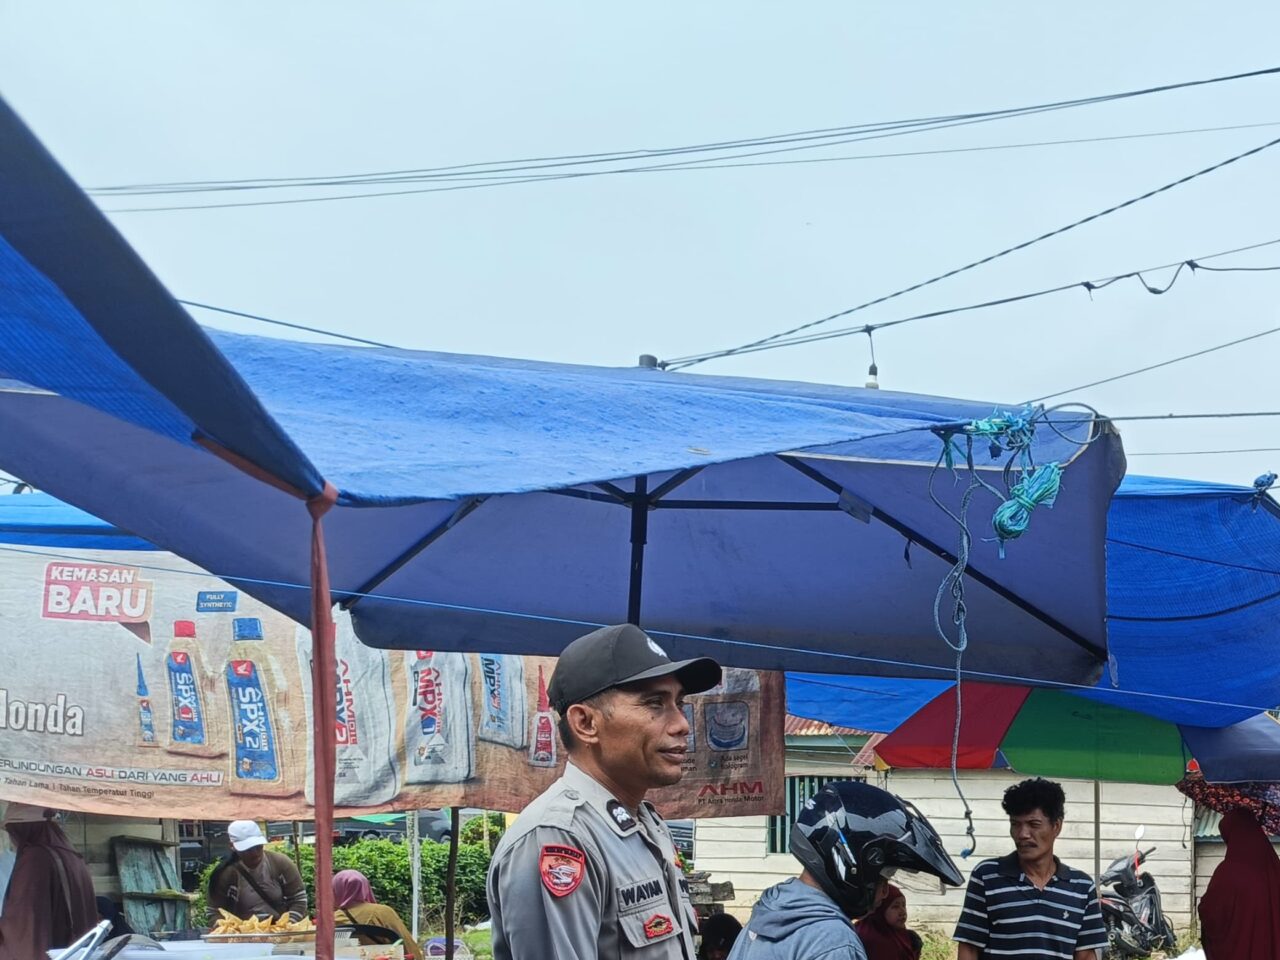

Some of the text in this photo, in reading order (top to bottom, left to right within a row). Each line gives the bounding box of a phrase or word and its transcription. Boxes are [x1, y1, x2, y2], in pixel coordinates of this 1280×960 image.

[50, 566, 135, 584] KEMASAN
[47, 584, 147, 618] BARU
[86, 768, 115, 779] ASLI
[118, 770, 149, 780] DARI
[152, 772, 188, 782] YANG
[190, 773, 221, 783] AHLI
[29, 780, 50, 789] Lama
[59, 784, 81, 793] Tahan
[130, 789, 155, 799] Tinggi
[698, 781, 763, 797] AHM
[620, 879, 663, 906] WAYAN
